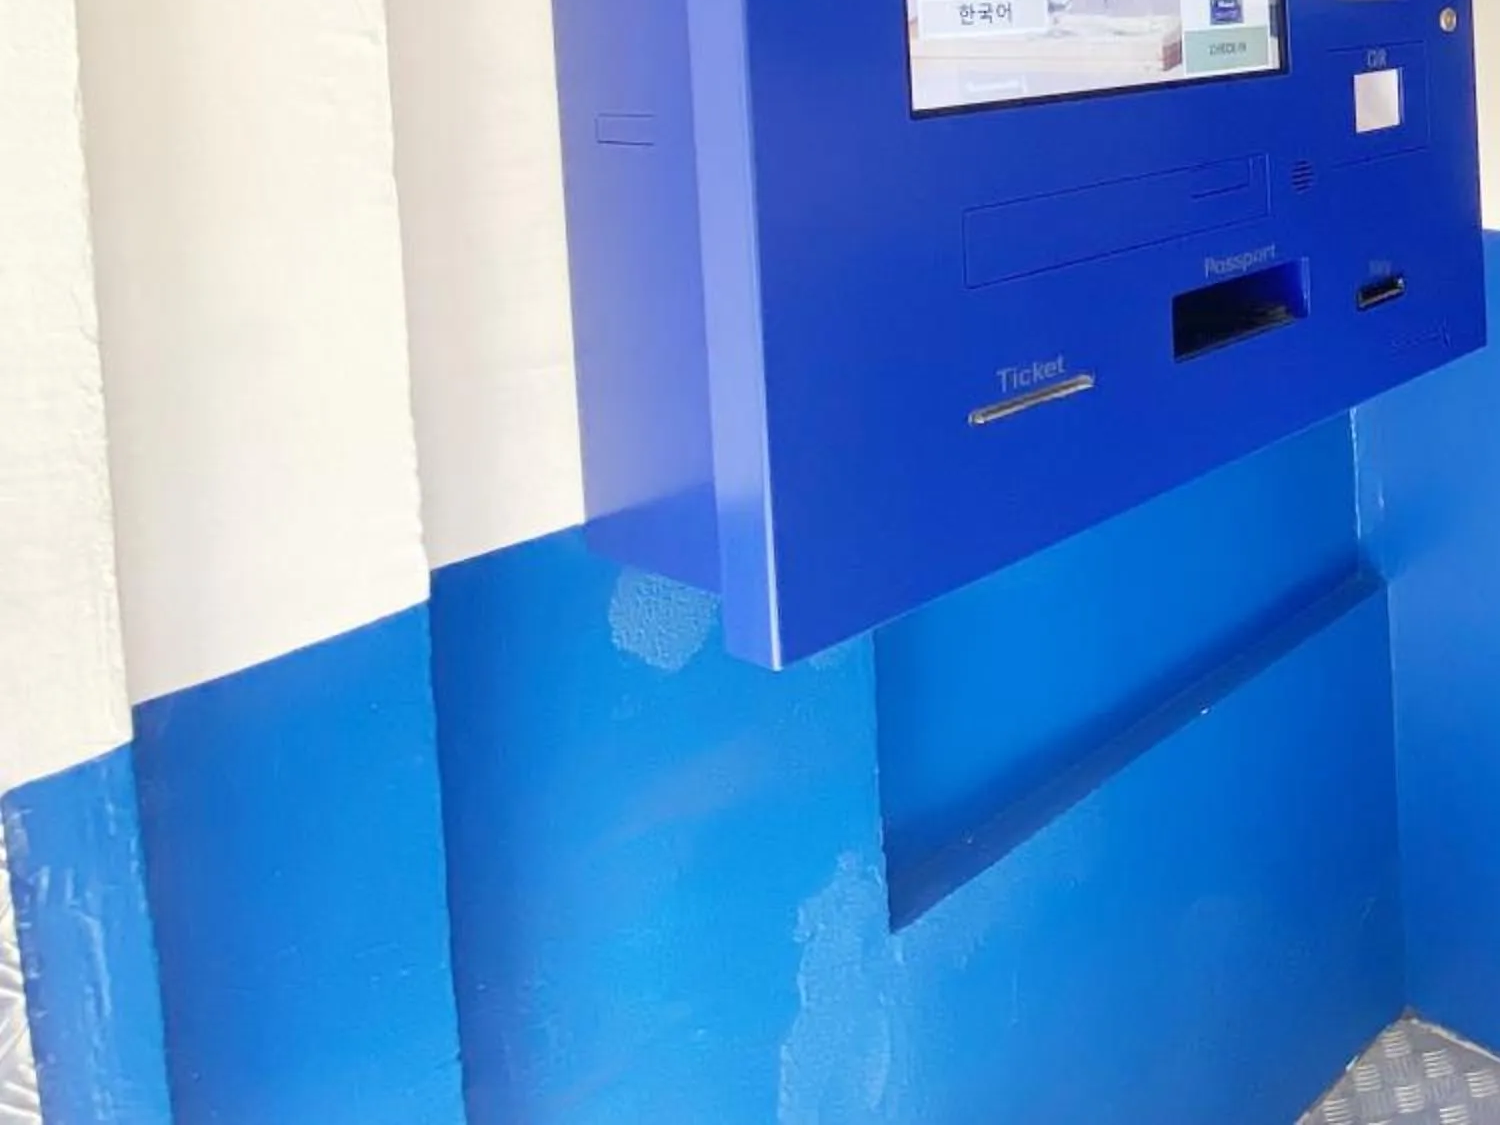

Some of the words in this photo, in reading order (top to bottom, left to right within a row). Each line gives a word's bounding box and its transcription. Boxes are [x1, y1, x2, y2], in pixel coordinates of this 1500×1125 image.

[959, 2, 1014, 26] 한국어
[1204, 243, 1277, 279] Passport
[996, 354, 1066, 393] Ticket
